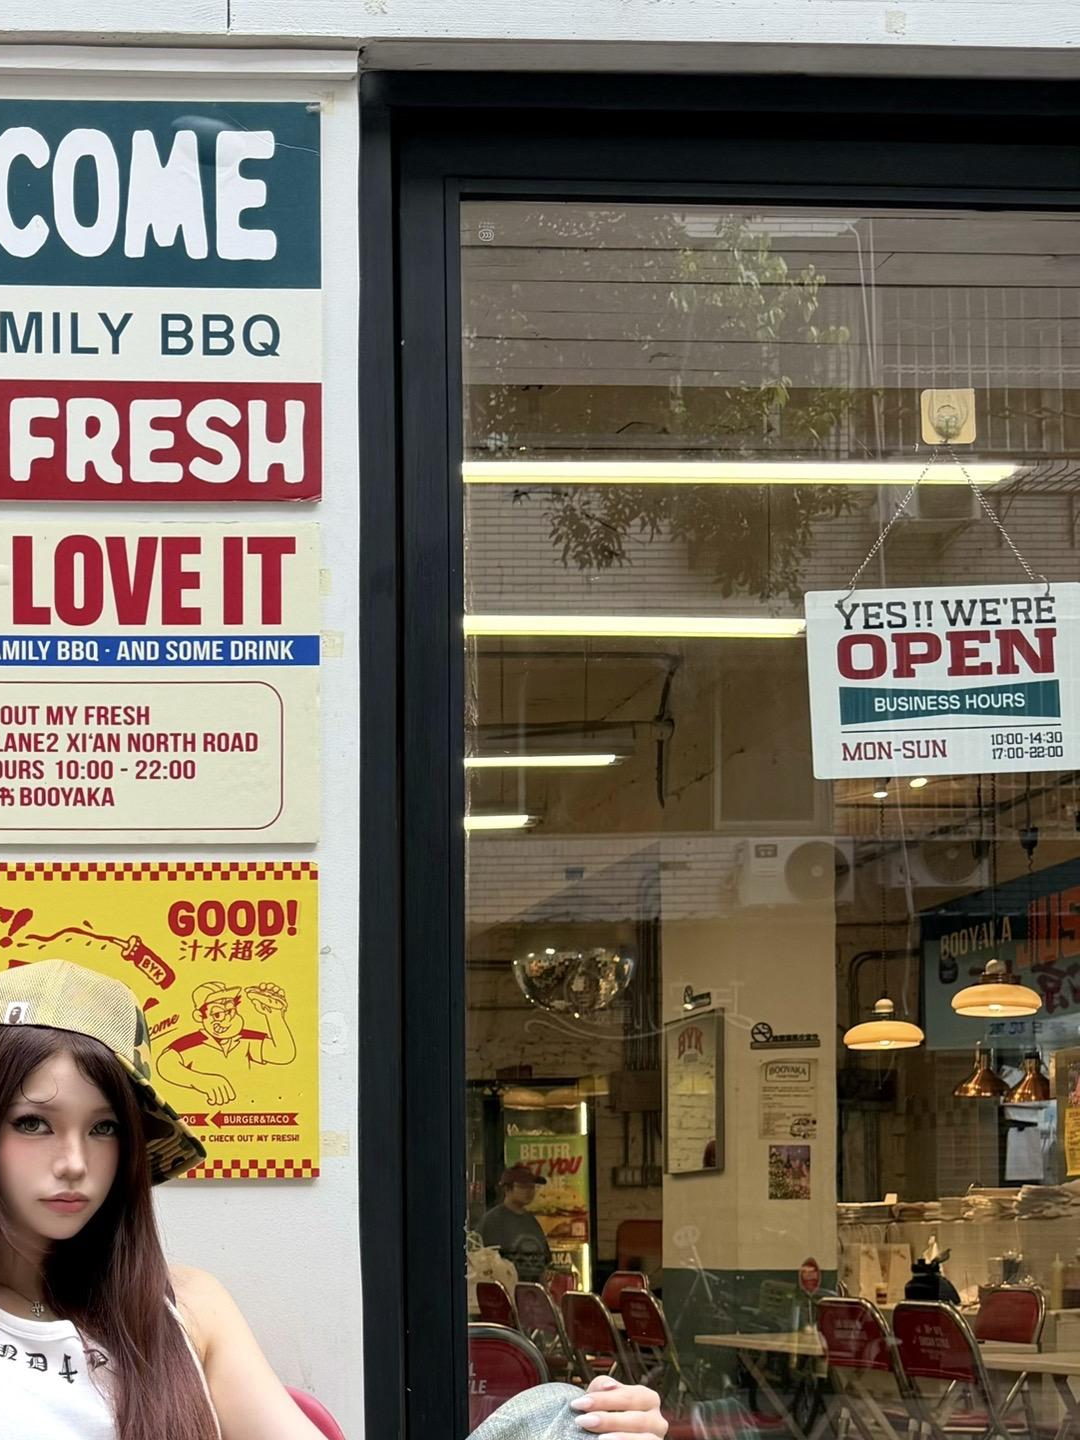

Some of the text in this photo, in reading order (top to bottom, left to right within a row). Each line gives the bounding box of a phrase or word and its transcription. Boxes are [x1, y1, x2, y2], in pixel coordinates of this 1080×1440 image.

[161, 312, 281, 357] BBQ
[9, 396, 306, 485] FRESH
[12, 534, 203, 626] LOVE
[223, 536, 297, 626] IT
[835, 596, 1057, 630] YES!! WE'RE
[57, 640, 99, 663] BBQ
[117, 639, 160, 661] AND
[165, 639, 224, 661] SOME
[230, 640, 294, 661] DRINK
[836, 628, 1057, 680] OPEN
[874, 693, 1025, 712] BUSINESS HOURS
[0, 705, 40, 726] OUT
[45, 706, 78, 726] MY
[84, 706, 150, 726] FRESH
[126, 732, 197, 753] NORTH
[203, 733, 259, 753] ROAD
[991, 731, 1063, 746] 10:00-14:30
[841, 739, 948, 761] MON-SUN
[55, 759, 113, 780] 10:00
[135, 760, 196, 780] 22:00
[19, 786, 115, 807] BOOYAKA
[167, 899, 299, 936] GOOD!
[178, 939, 278, 962] 汁水超多
[141, 957, 165, 981] BYK
[223, 1114, 289, 1124] BURGER&TACO
[209, 1134, 235, 1142] CHECK
[238, 1134, 254, 1142] OUT
[257, 1134, 269, 1142] MY
[520, 1143, 570, 1160] BETTER
[547, 1155, 583, 1177] YOU
